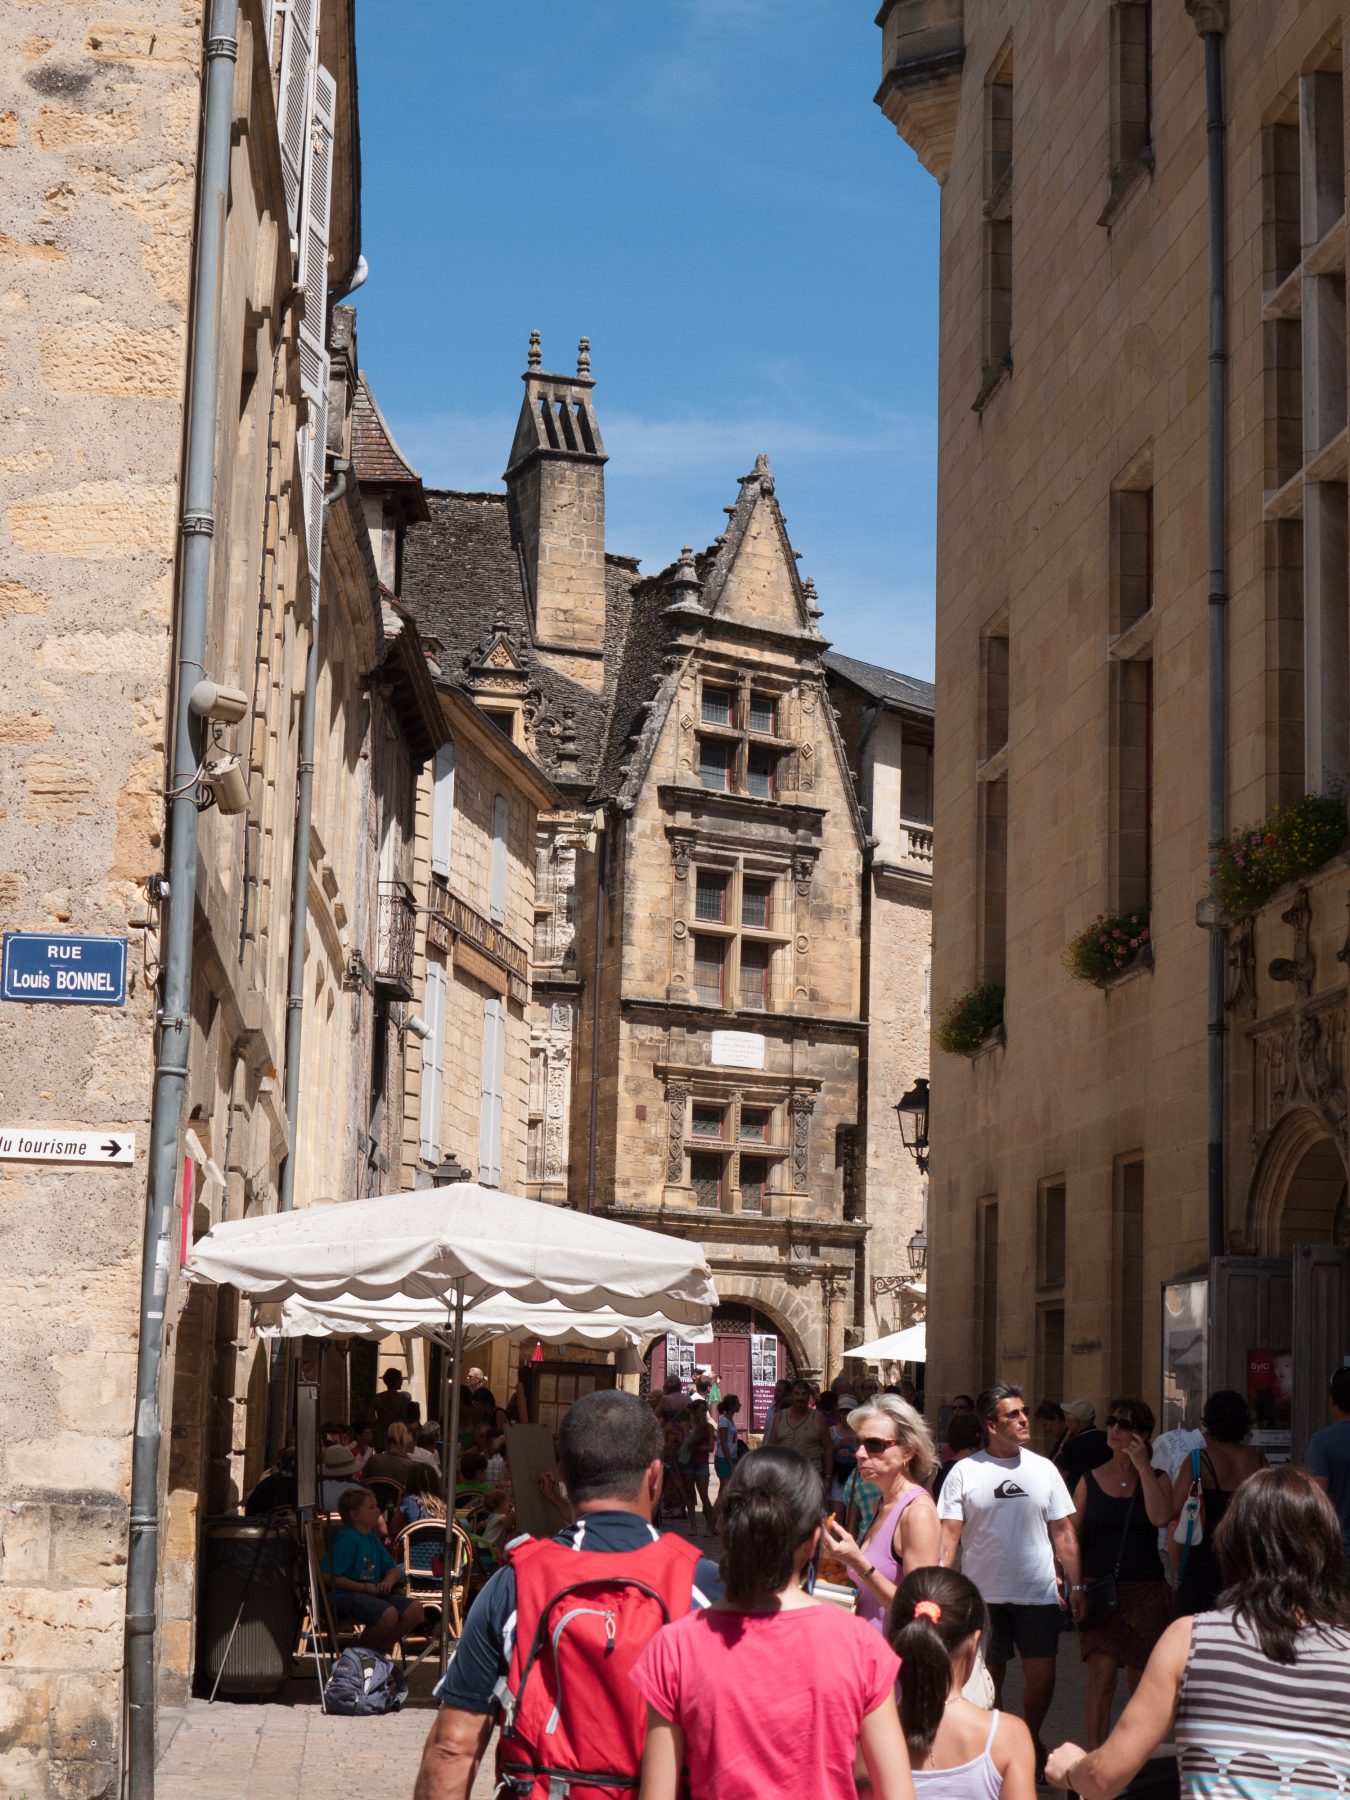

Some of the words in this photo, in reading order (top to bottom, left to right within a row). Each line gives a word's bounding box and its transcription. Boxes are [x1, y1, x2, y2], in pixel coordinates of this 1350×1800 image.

[47, 945, 82, 959] RUE
[13, 969, 50, 989] Louis
[56, 970, 115, 991] BONNEL
[18, 1137, 87, 1155] tourisme
